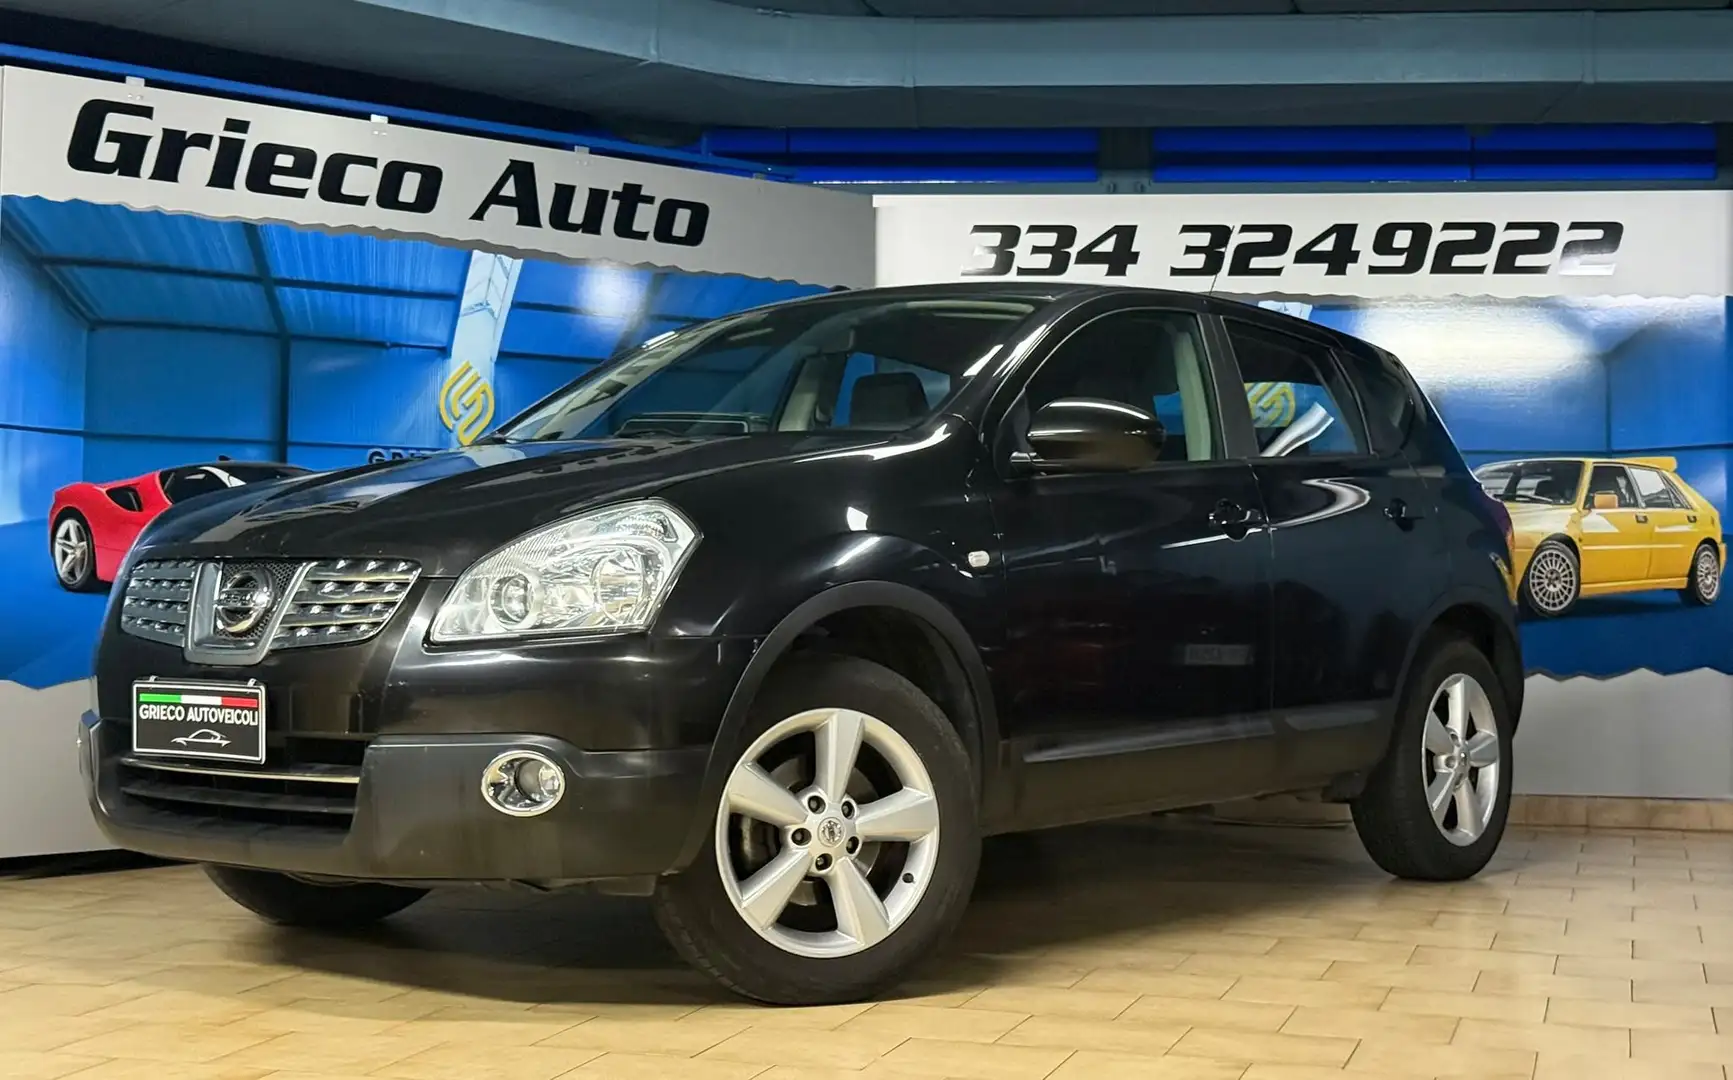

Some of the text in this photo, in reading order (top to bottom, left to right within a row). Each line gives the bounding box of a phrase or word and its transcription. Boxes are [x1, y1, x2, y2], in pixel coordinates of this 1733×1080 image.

[67, 98, 710, 247] Grieco Auto
[960, 222, 1624, 277] 334 3249222
[138, 703, 259, 726] GRIECO AUTOVEICOLI
